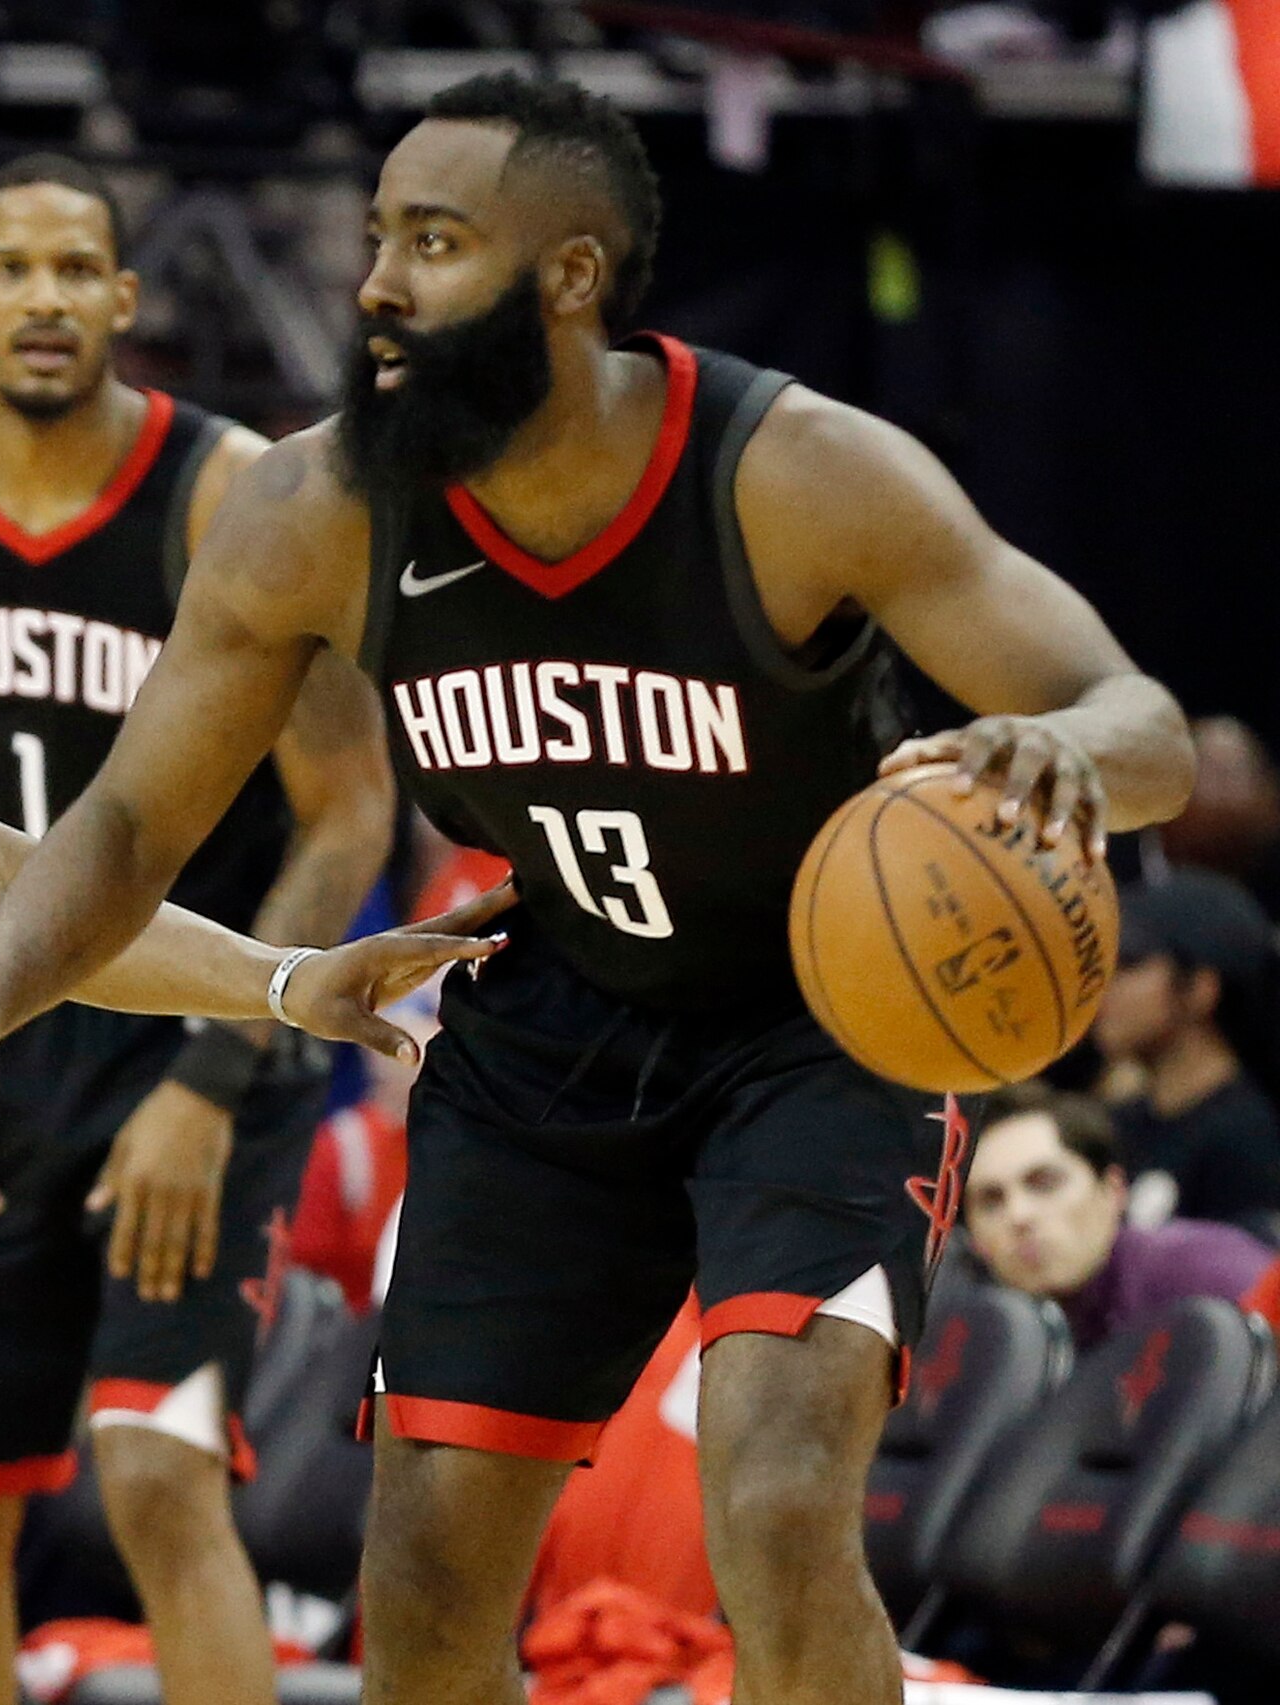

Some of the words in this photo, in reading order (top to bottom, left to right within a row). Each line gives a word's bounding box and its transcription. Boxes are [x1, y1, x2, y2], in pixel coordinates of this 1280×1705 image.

[393, 660, 747, 774] HOUSTON
[12, 731, 48, 841] 1
[527, 804, 674, 939] 13
